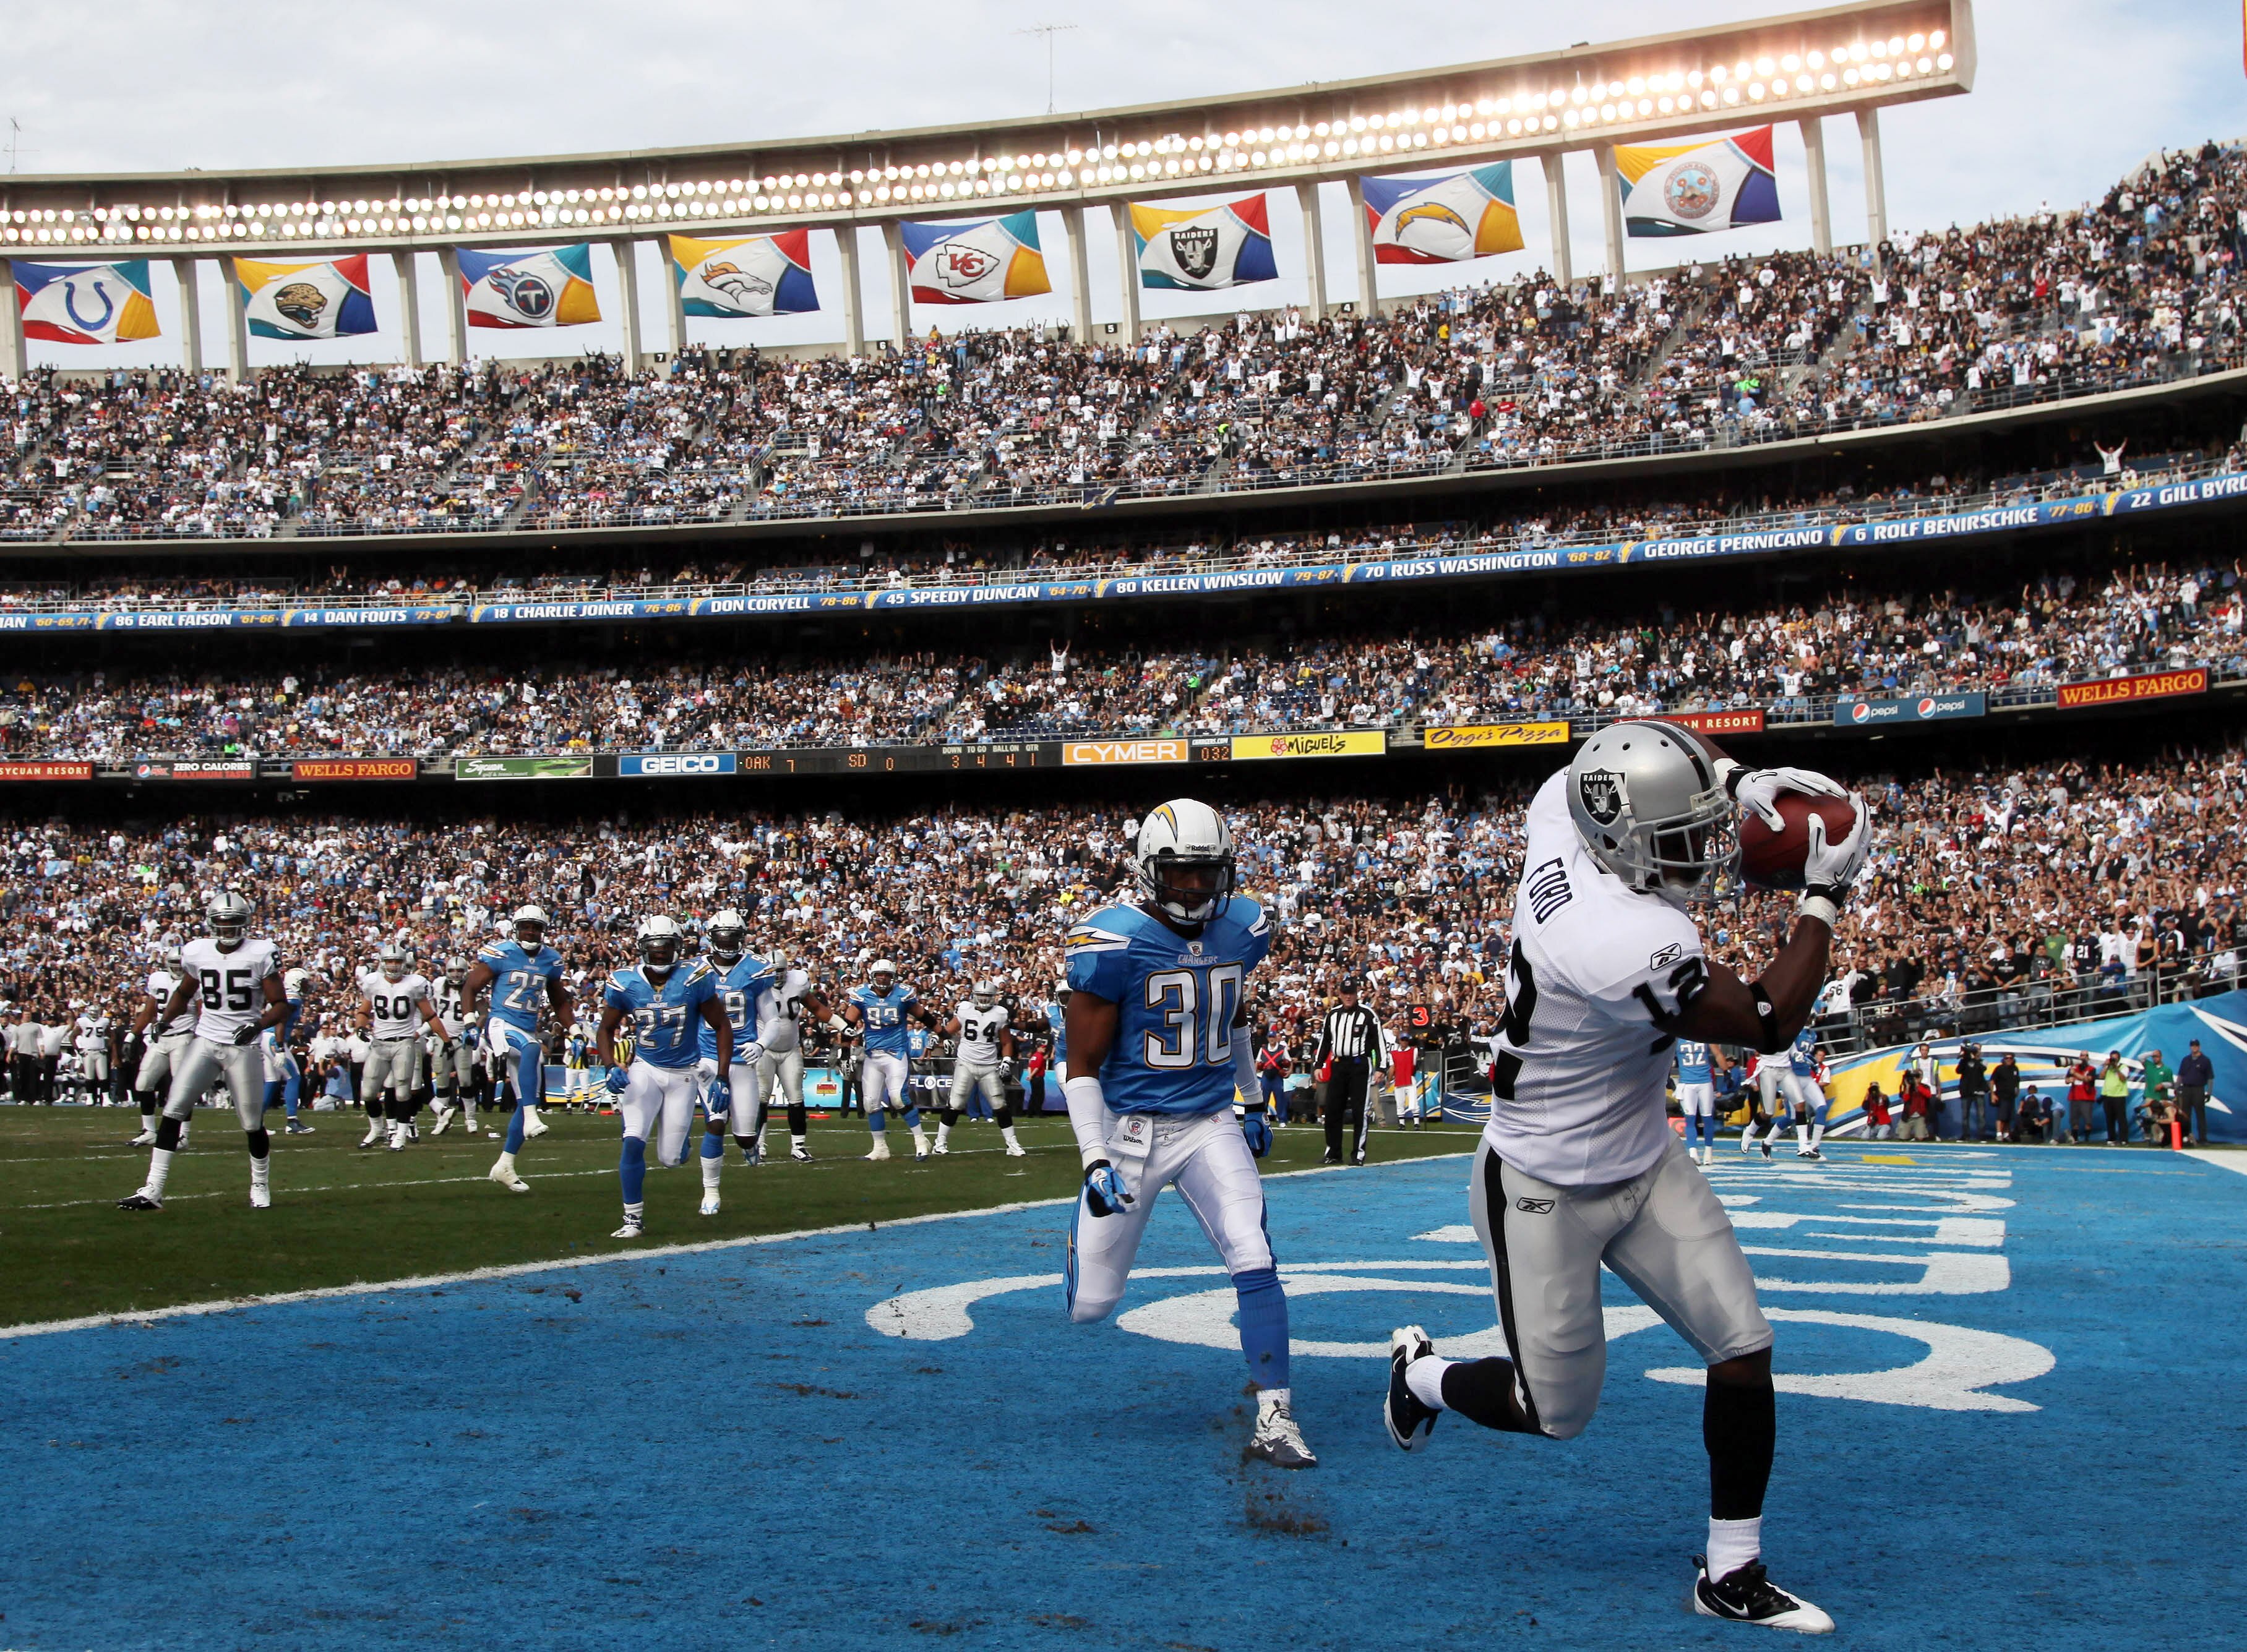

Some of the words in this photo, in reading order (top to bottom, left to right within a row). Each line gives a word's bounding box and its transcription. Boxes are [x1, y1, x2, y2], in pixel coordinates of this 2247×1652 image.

[1174, 228, 1214, 239] RAIDERS
[950, 254, 985, 277] KC
[2131, 492, 2151, 509] 22
[2159, 486, 2199, 505] GILL
[1855, 528, 1867, 542] 6
[1873, 522, 1920, 541] ROLF
[1923, 507, 2039, 536] BENIRSCHKE
[1644, 539, 1716, 558] GEORGE
[1720, 529, 1824, 553] PERNICANO
[1365, 565, 1385, 578] 70
[1391, 562, 1436, 577] RUSS
[1440, 552, 1558, 574] WASHINGTON
[1116, 581, 1136, 594] 80
[1141, 576, 1200, 593] KELLEN
[1203, 571, 1285, 590] WINSLOW
[887, 593, 904, 604] 45
[911, 588, 971, 604] SPEEDY
[973, 586, 1040, 602] DUNCAN
[494, 607, 509, 619] 18
[515, 605, 580, 619] CHARLIE
[580, 602, 635, 617] JOINER
[711, 598, 745, 613] DON
[747, 596, 810, 612] CORYELL
[115, 615, 134, 627] 86
[139, 614, 174, 627] EARL
[178, 614, 232, 626] FAISON
[304, 612, 318, 623] 14
[325, 611, 357, 623] DAN
[358, 610, 407, 623] FOUTS
[2062, 682, 2130, 704] WELLS
[2134, 673, 2202, 696] FARGO
[1870, 705, 1898, 718] pepsi
[1937, 700, 1965, 713] pepsi
[1706, 716, 1758, 729] RESORT
[1430, 729, 1493, 746] Oggi's
[1498, 725, 1563, 742] Pizza
[848, 754, 867, 767] SD
[1006, 753, 1015, 767] 4
[1031, 753, 1035, 766] 1
[1073, 743, 1177, 762] CYMER
[173, 763, 200, 771] ZERO
[202, 762, 252, 771] CALORIES
[298, 764, 353, 777] WELLS
[356, 763, 411, 776] FARGO
[465, 760, 507, 776] Sycuan
[641, 755, 720, 774] GEICO
[745, 756, 770, 769] OAK
[786, 759, 794, 773] 7
[885, 757, 894, 771] 0
[952, 755, 960, 769] 3
[977, 755, 985, 768] 4
[0, 766, 41, 776] SYCUAN
[47, 766, 89, 775] RESORT
[225, 771, 251, 779] TASTE
[1583, 774, 1615, 782] RAIDER
[1526, 857, 1573, 925] FORD
[271, 951, 283, 969] 8
[1177, 954, 1218, 964] CHARGERS
[2077, 945, 2089, 959] 21
[200, 969, 254, 1011] 85
[502, 969, 547, 1013] 23
[156, 988, 170, 1014] 2
[374, 995, 411, 1021] 80
[704, 991, 747, 1030] 9
[866, 1007, 900, 1030] 93
[1145, 961, 1244, 1070] 30
[1412, 1006, 1430, 1027] 3
[85, 1026, 104, 1038] 75
[633, 1004, 689, 1050] 27
[963, 1019, 998, 1043] 64
[910, 1038, 922, 1050] 56
[1679, 1043, 1706, 1066] 32
[1123, 1134, 1145, 1145] Wilson
